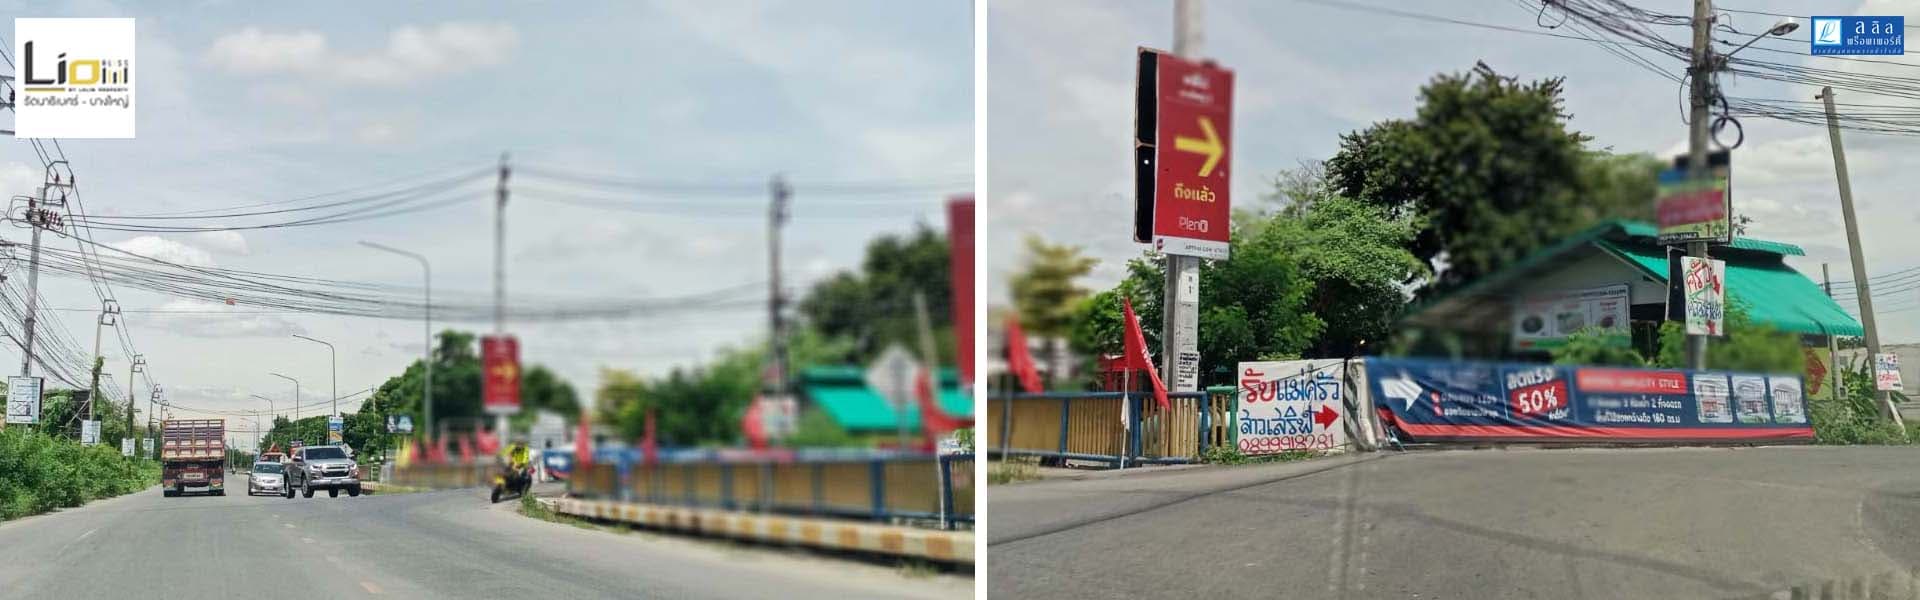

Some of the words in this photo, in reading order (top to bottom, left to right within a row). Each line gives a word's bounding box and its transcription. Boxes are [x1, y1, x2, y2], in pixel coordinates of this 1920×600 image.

[1174, 182, 1216, 203] ถึงแล้ว
[1518, 385, 1559, 414] 50%
